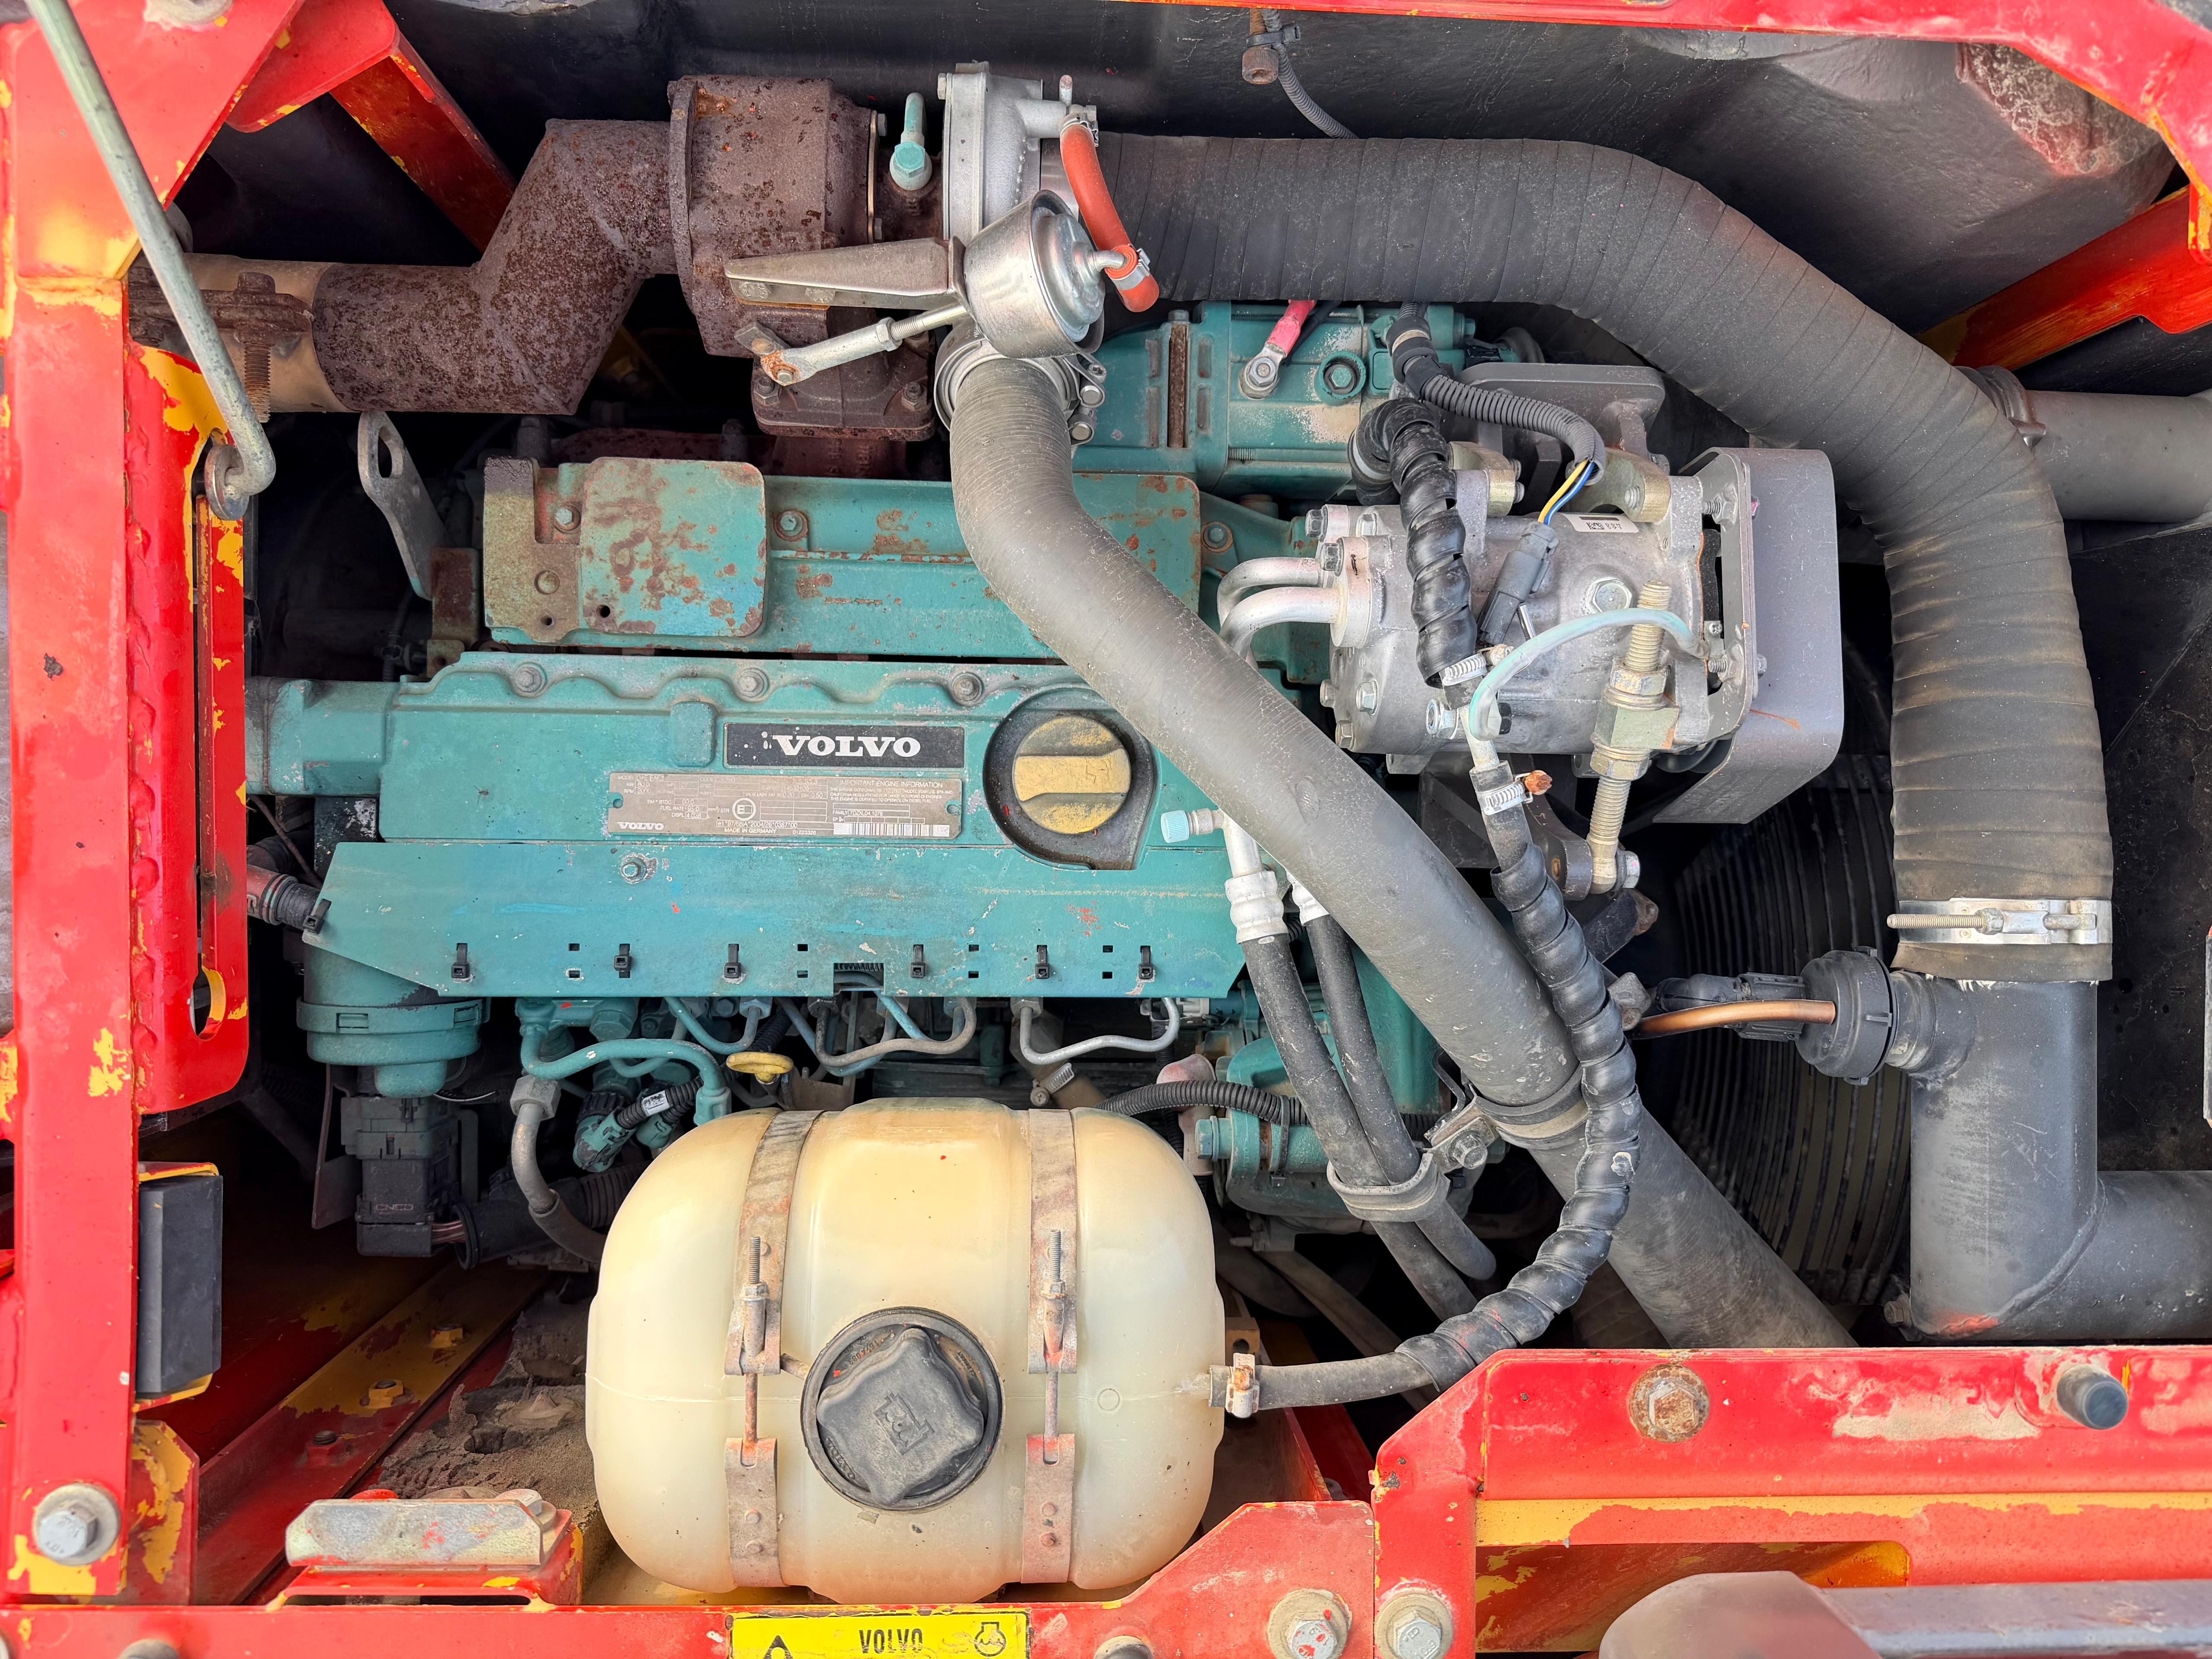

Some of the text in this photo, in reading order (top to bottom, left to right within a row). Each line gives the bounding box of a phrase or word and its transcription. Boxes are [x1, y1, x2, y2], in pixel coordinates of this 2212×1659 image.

[773, 735, 921, 757] VOLVO
[617, 822, 664, 830] VOLVO
[827, 1436, 856, 1479] VOLVO
[858, 1628, 923, 1654] VOLVO
